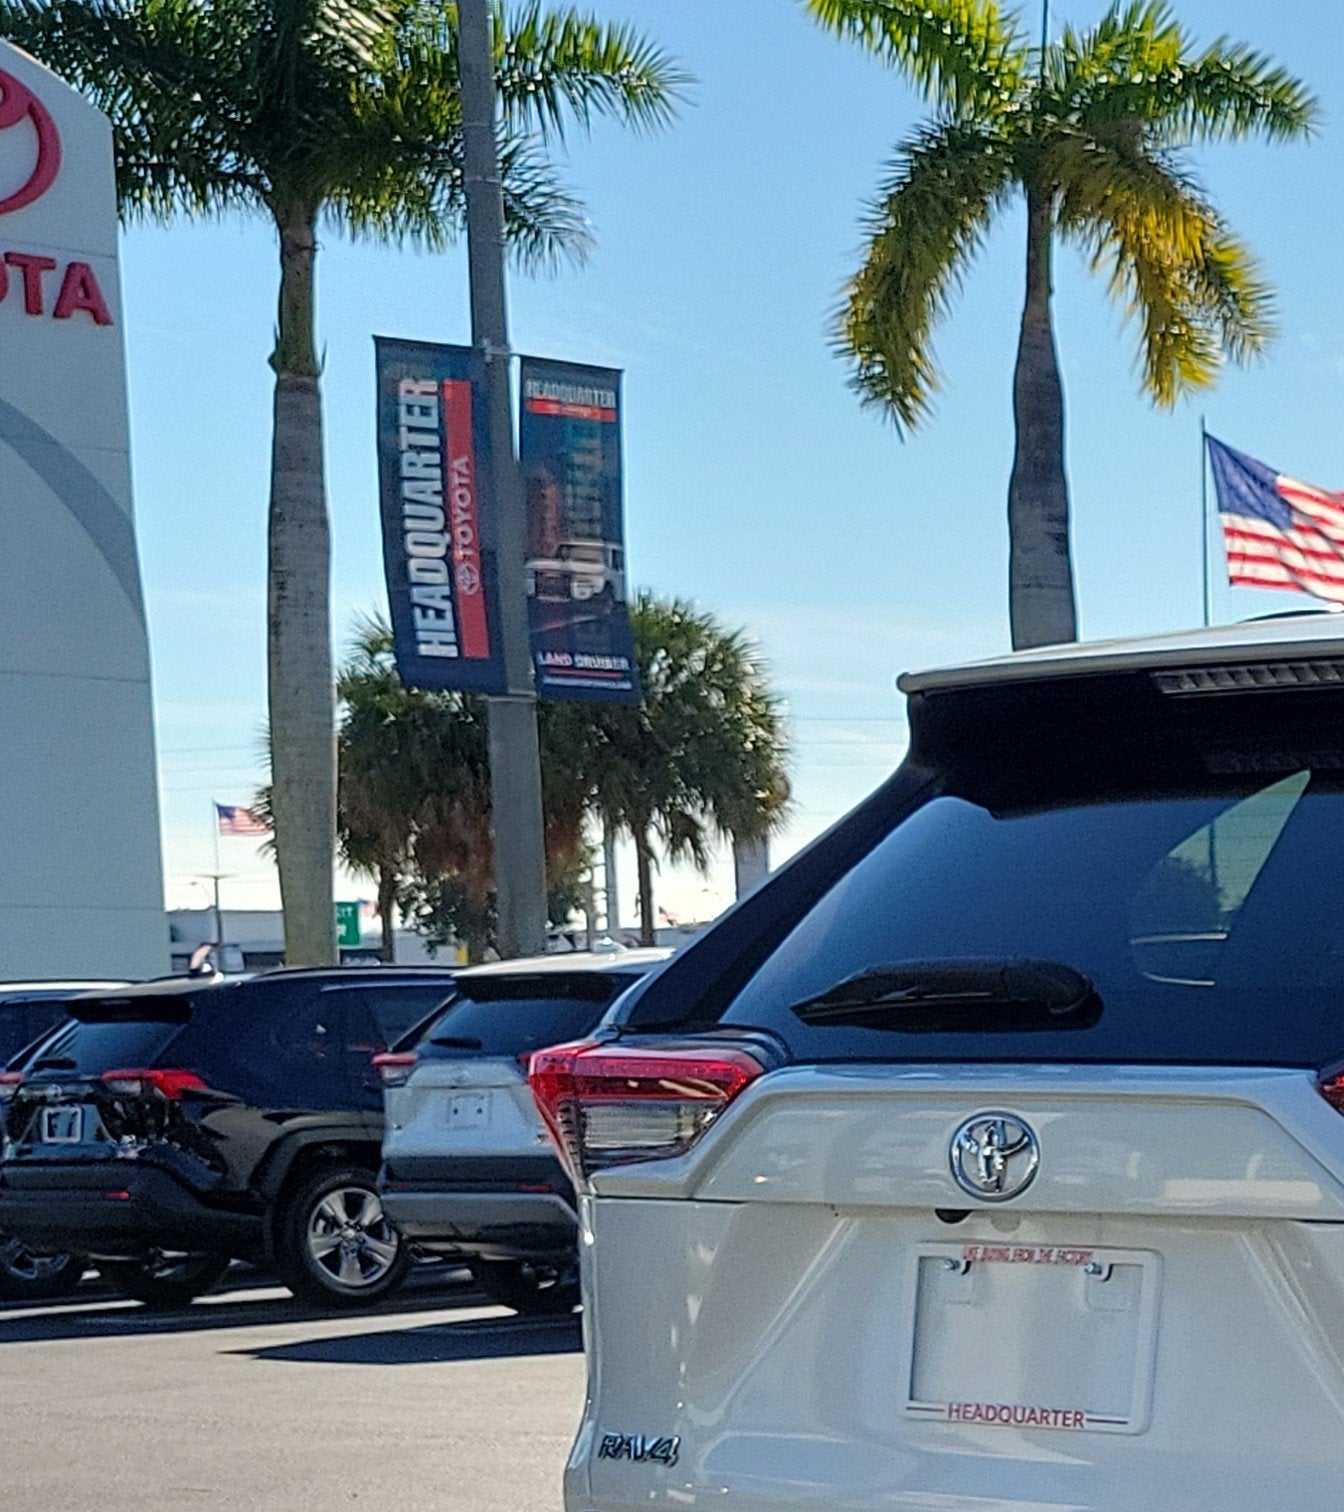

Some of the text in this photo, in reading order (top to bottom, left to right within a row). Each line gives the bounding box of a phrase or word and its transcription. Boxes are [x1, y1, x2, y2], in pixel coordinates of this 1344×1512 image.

[0, 252, 114, 326] TA
[400, 379, 460, 658] HEADQUARTER
[451, 455, 477, 561] TOYOTA
[598, 1431, 681, 1467] RAV4
[948, 1402, 1084, 1428] HEADQUARTER
